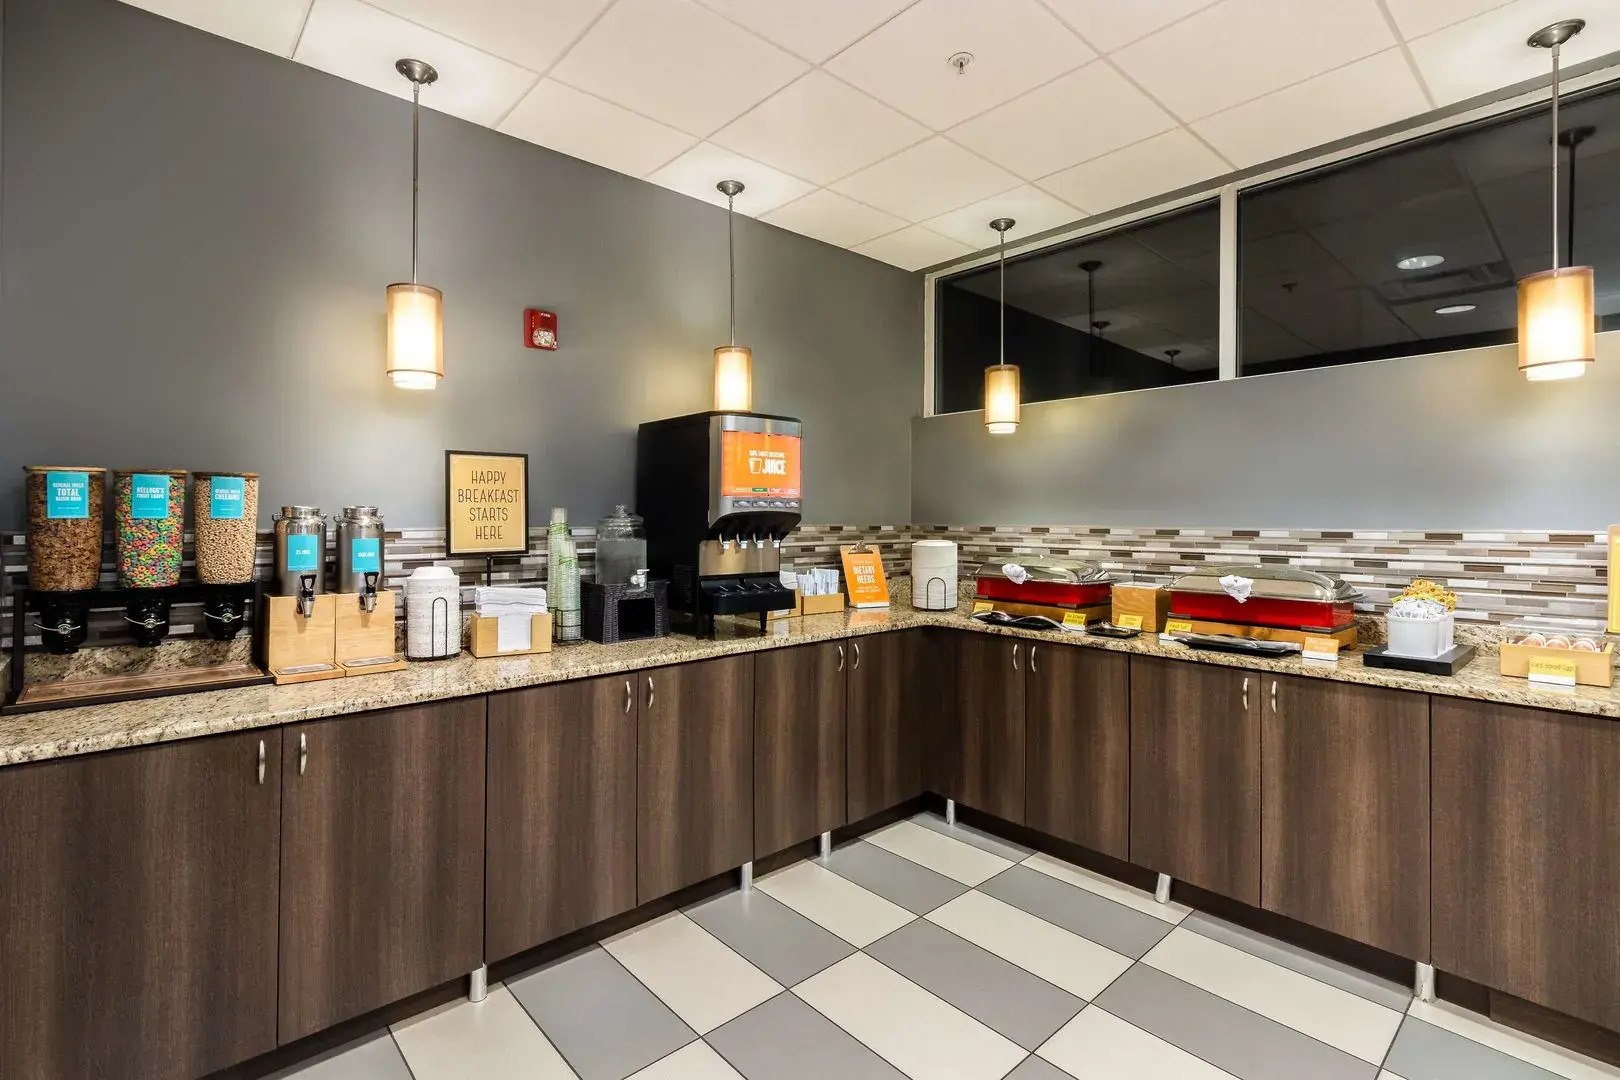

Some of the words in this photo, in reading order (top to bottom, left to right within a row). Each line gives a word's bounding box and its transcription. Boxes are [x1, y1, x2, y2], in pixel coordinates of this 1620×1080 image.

[761, 458, 786, 475] JUICE
[471, 470, 507, 485] HAPPY
[57, 488, 80, 496] TOTAL
[457, 488, 520, 504] BREAKFAST
[469, 507, 509, 522] STARTS
[475, 525, 503, 540] HERE
[856, 574, 876, 584] NEEDS
